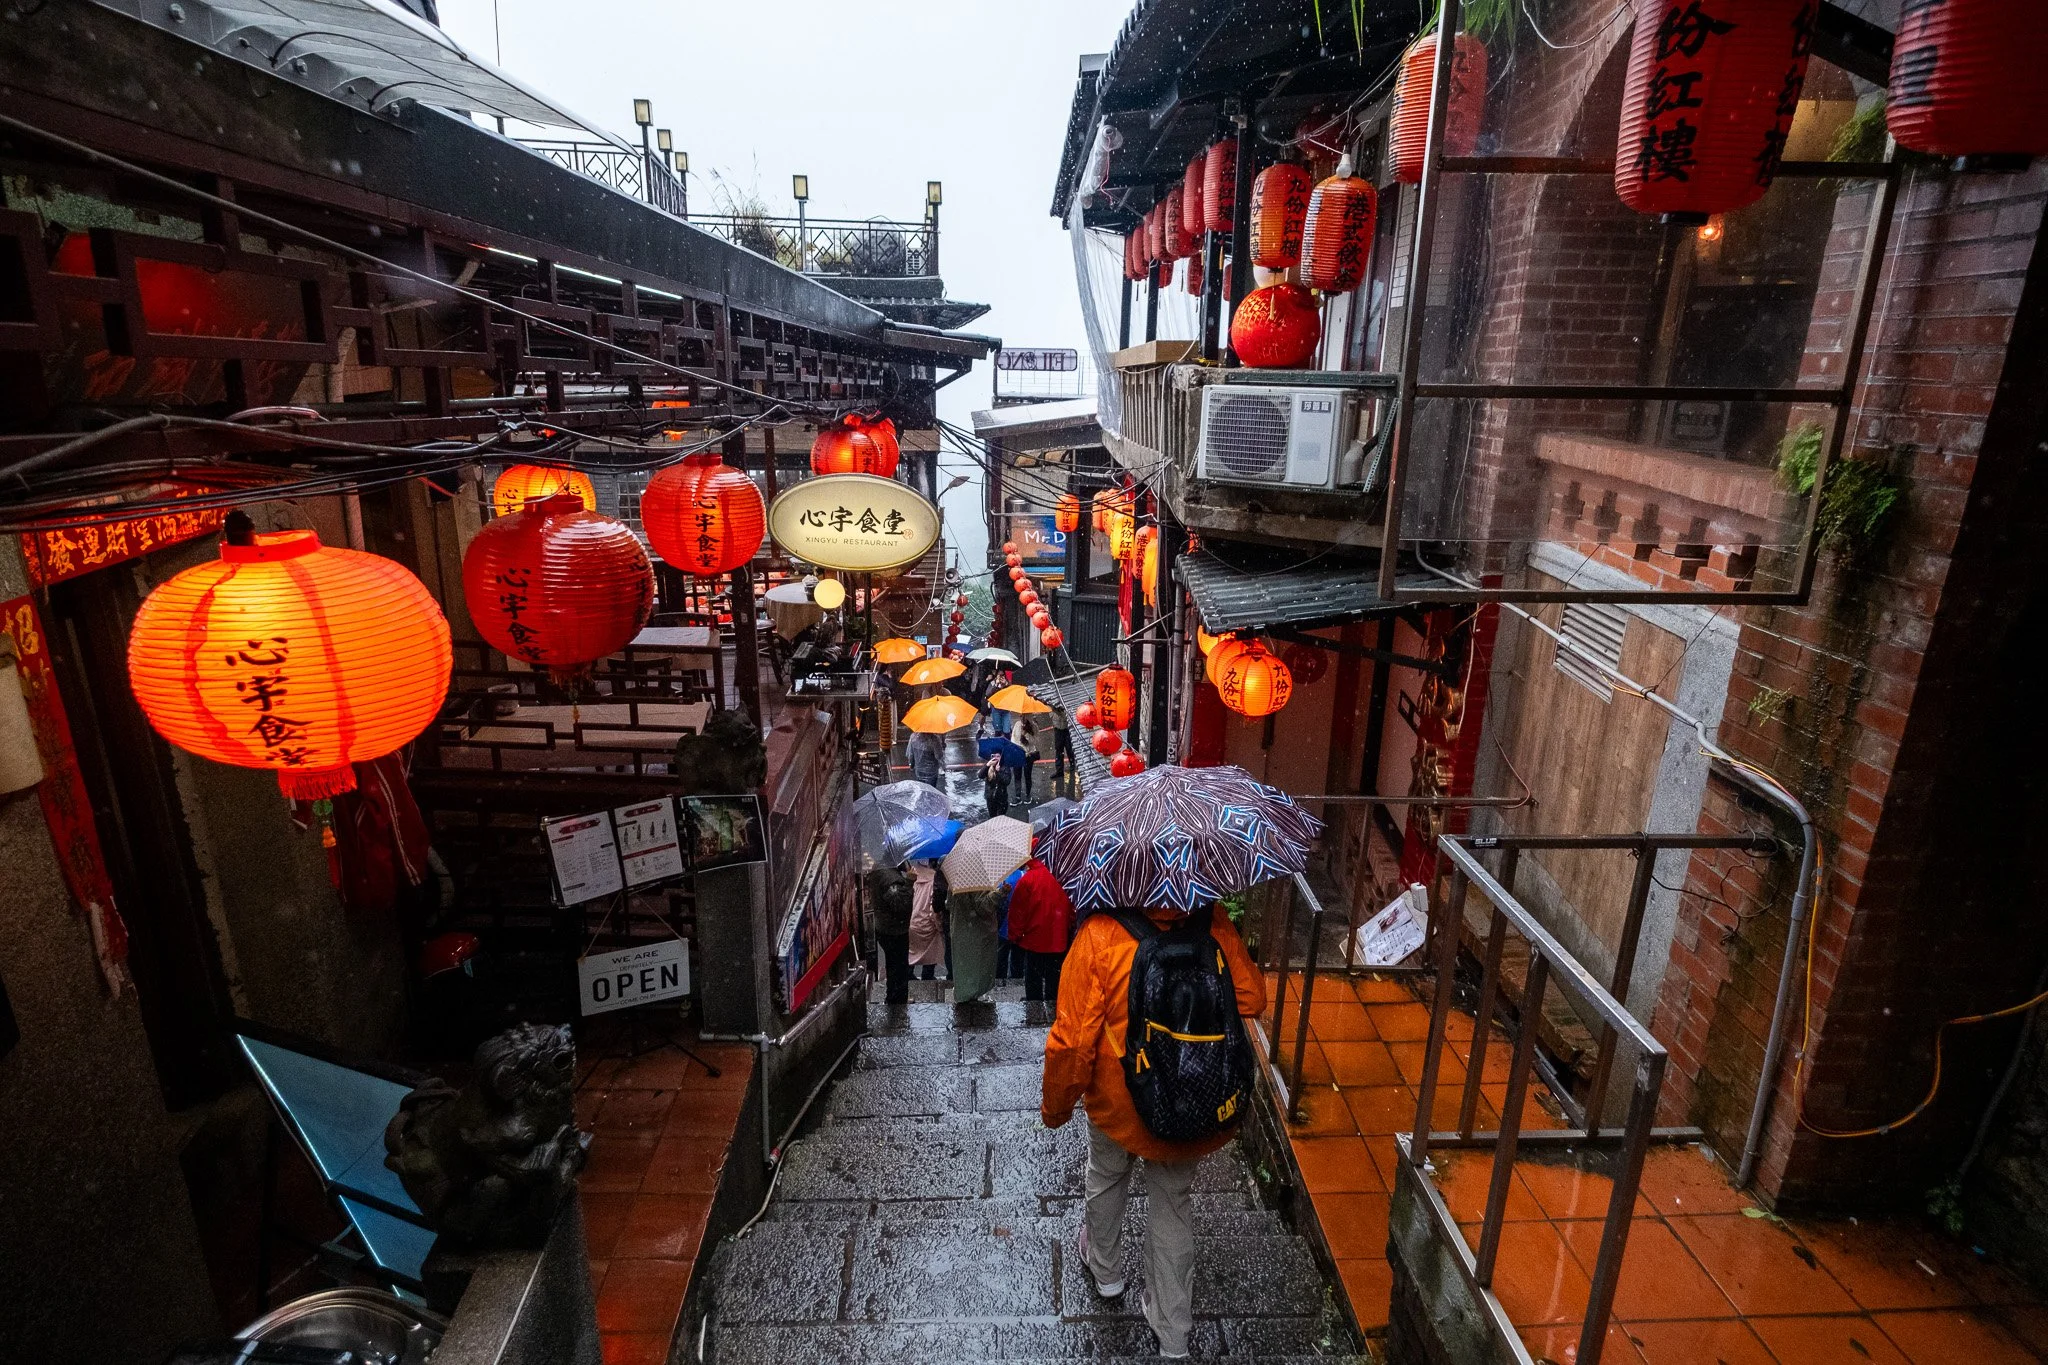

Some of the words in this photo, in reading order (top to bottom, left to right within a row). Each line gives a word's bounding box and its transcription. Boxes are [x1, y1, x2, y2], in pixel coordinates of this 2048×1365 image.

[1281, 177, 1306, 259] 九份紅樓
[692, 495, 721, 567] 心宇食堂
[800, 506, 905, 534] 心宇食堂
[1119, 519, 1134, 559] 九份紅樓
[806, 536, 838, 544] XINGYU
[843, 538, 899, 547] RESTAURANT
[496, 568, 546, 659] 心宇食堂
[225, 637, 320, 766] 心宇食堂
[1101, 682, 1117, 729] 九份紅樓
[612, 956, 630, 964] WE
[634, 951, 659, 960] ARE
[592, 963, 678, 1002] OPEN
[620, 997, 637, 1005] COME
[1217, 1089, 1240, 1122] CAT
